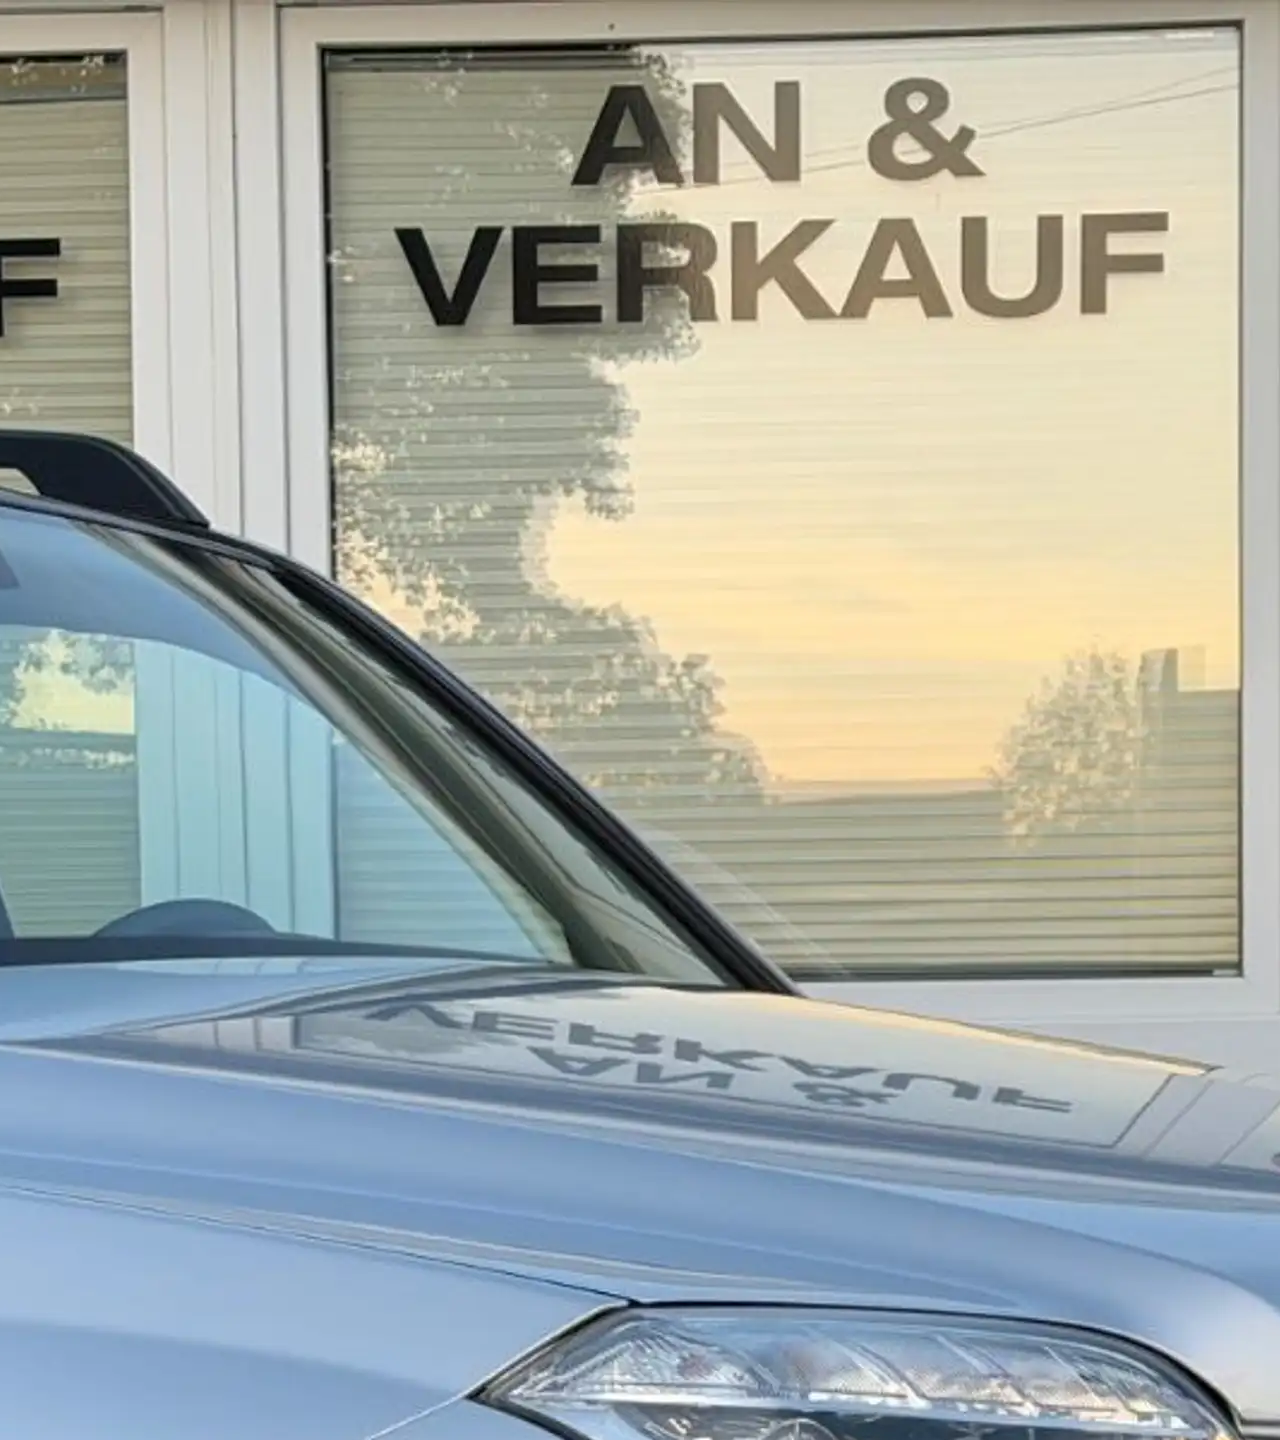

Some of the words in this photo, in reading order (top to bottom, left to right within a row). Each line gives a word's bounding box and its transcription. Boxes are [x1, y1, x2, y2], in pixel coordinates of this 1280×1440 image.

[572, 81, 801, 186] AN
[867, 77, 986, 182] &
[395, 210, 1169, 327] VERKAUF
